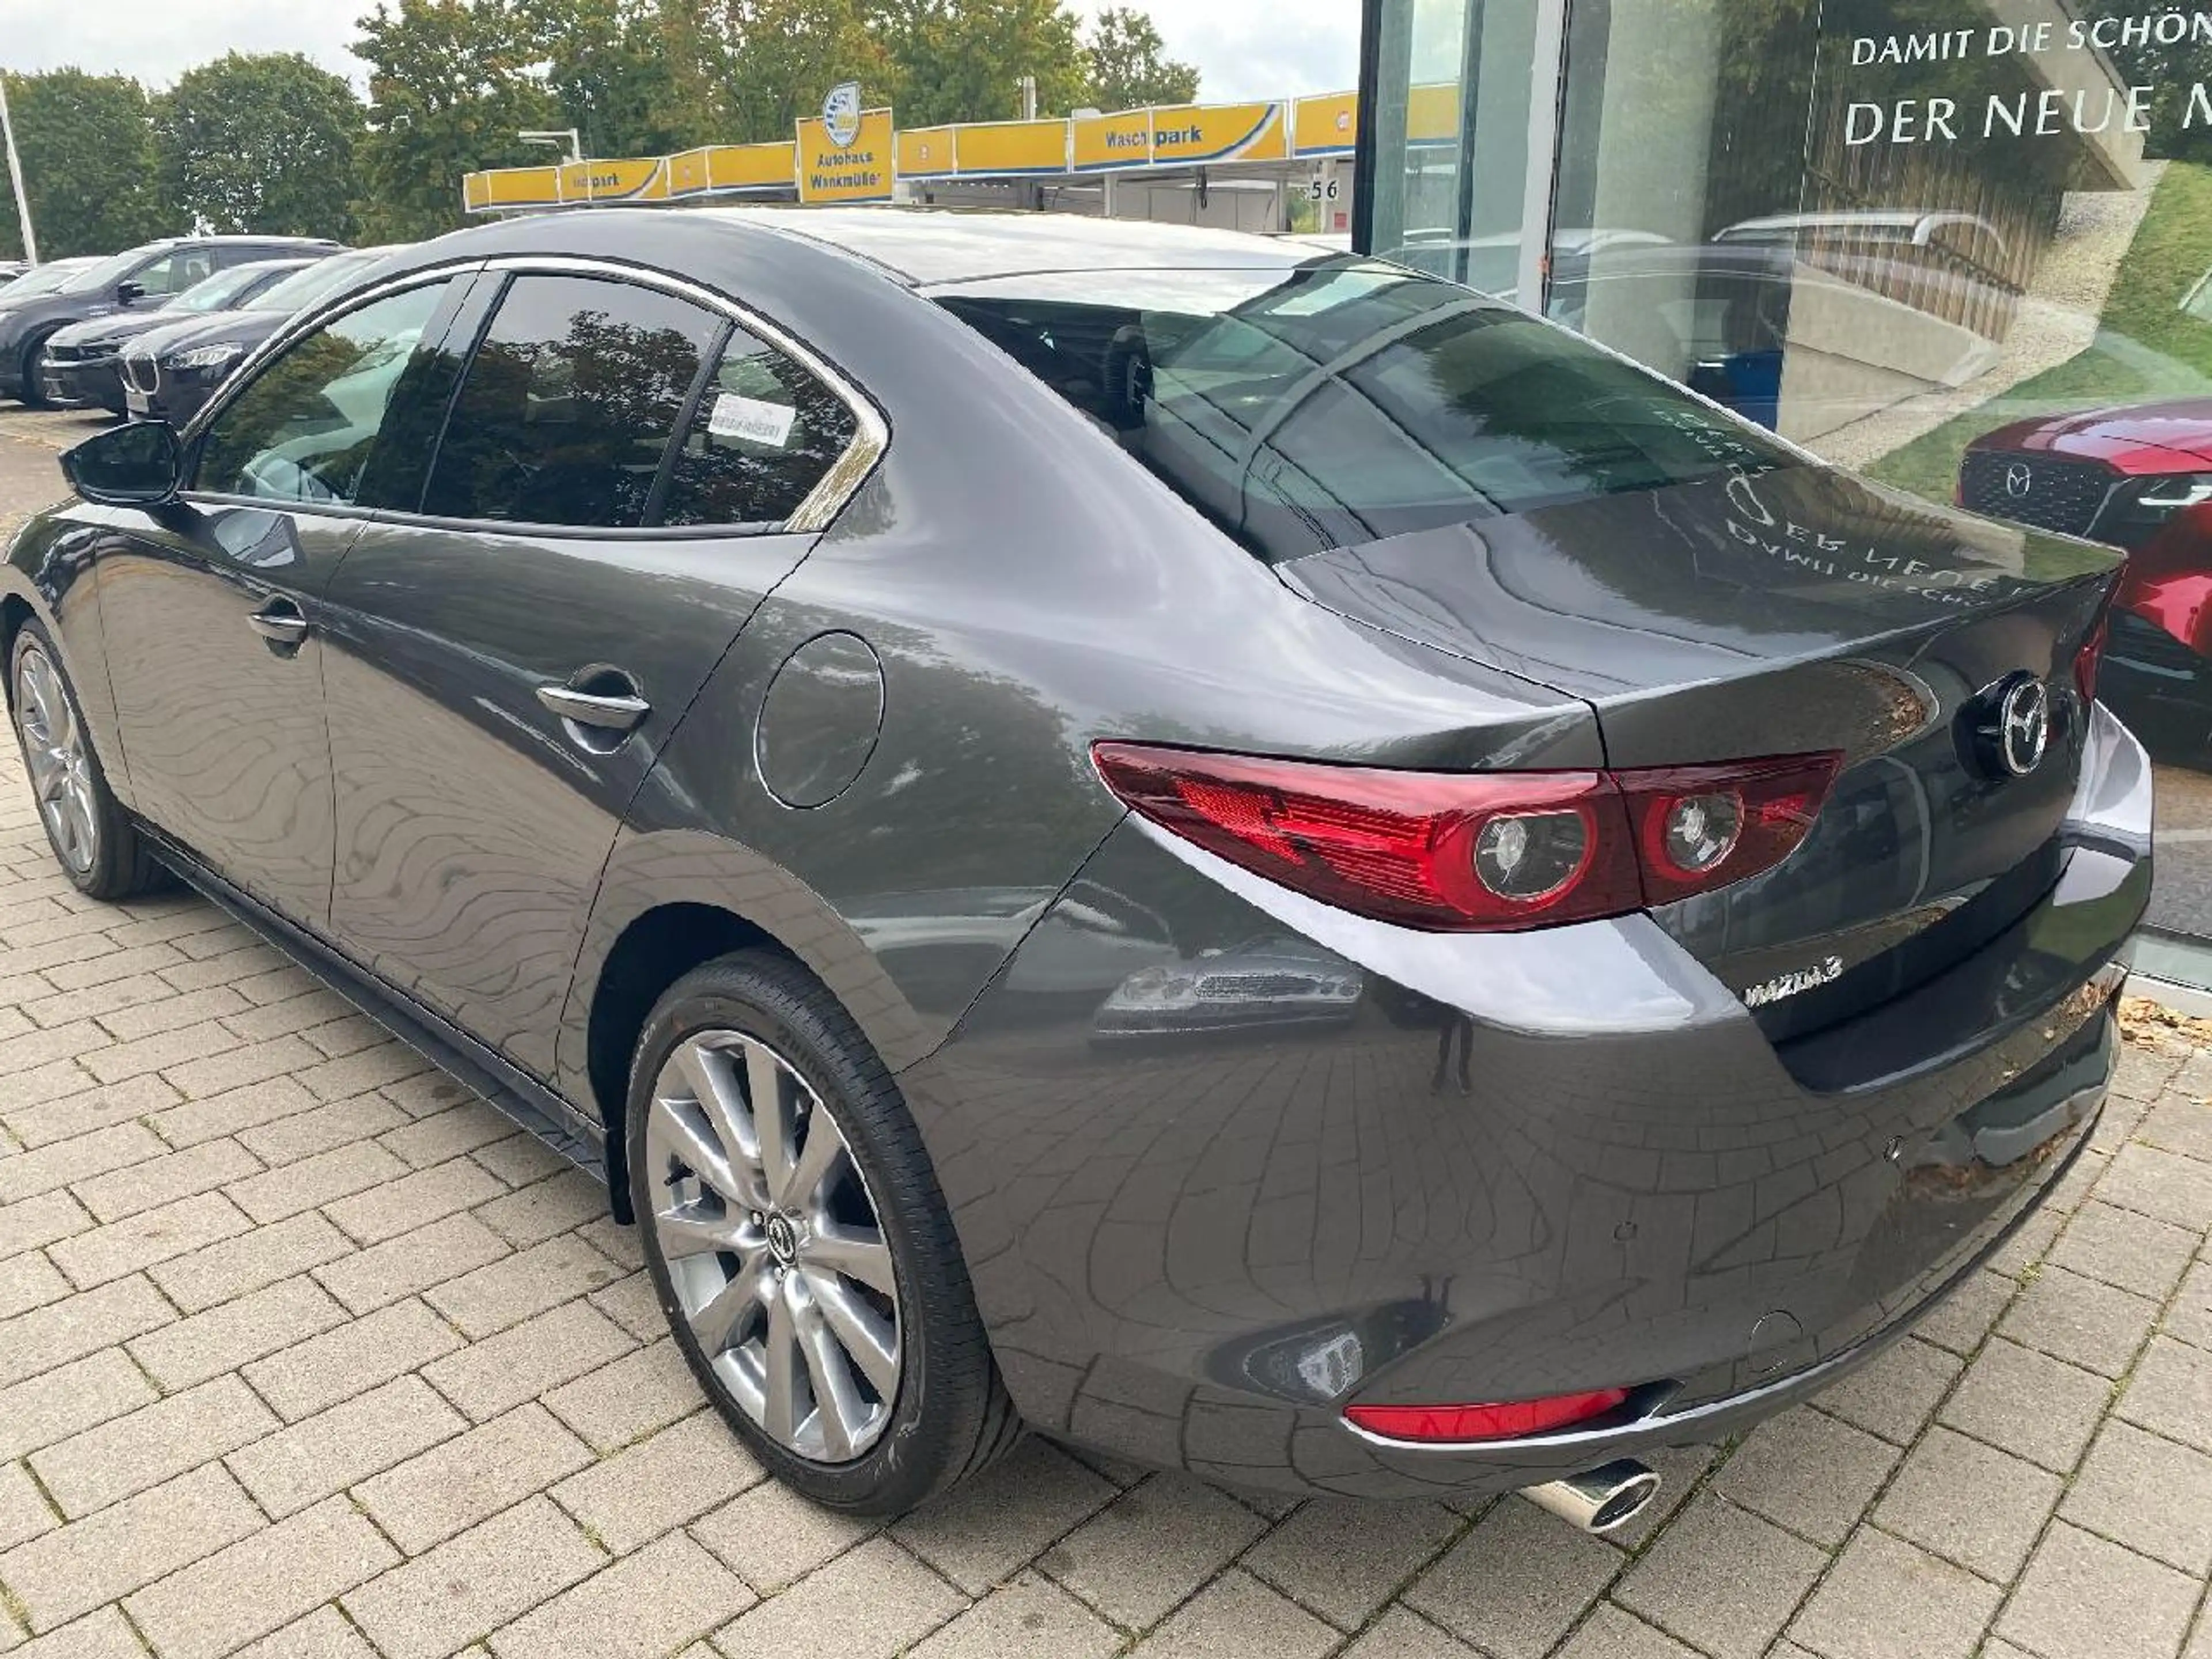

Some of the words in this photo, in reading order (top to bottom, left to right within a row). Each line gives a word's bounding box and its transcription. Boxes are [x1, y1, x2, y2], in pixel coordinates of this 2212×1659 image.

[1852, 29, 1974, 65] DAMIT
[1987, 22, 2052, 56] DIE
[1845, 97, 1957, 145] DER
[1983, 86, 2153, 137] NEUE
[1327, 180, 1337, 198] 6
